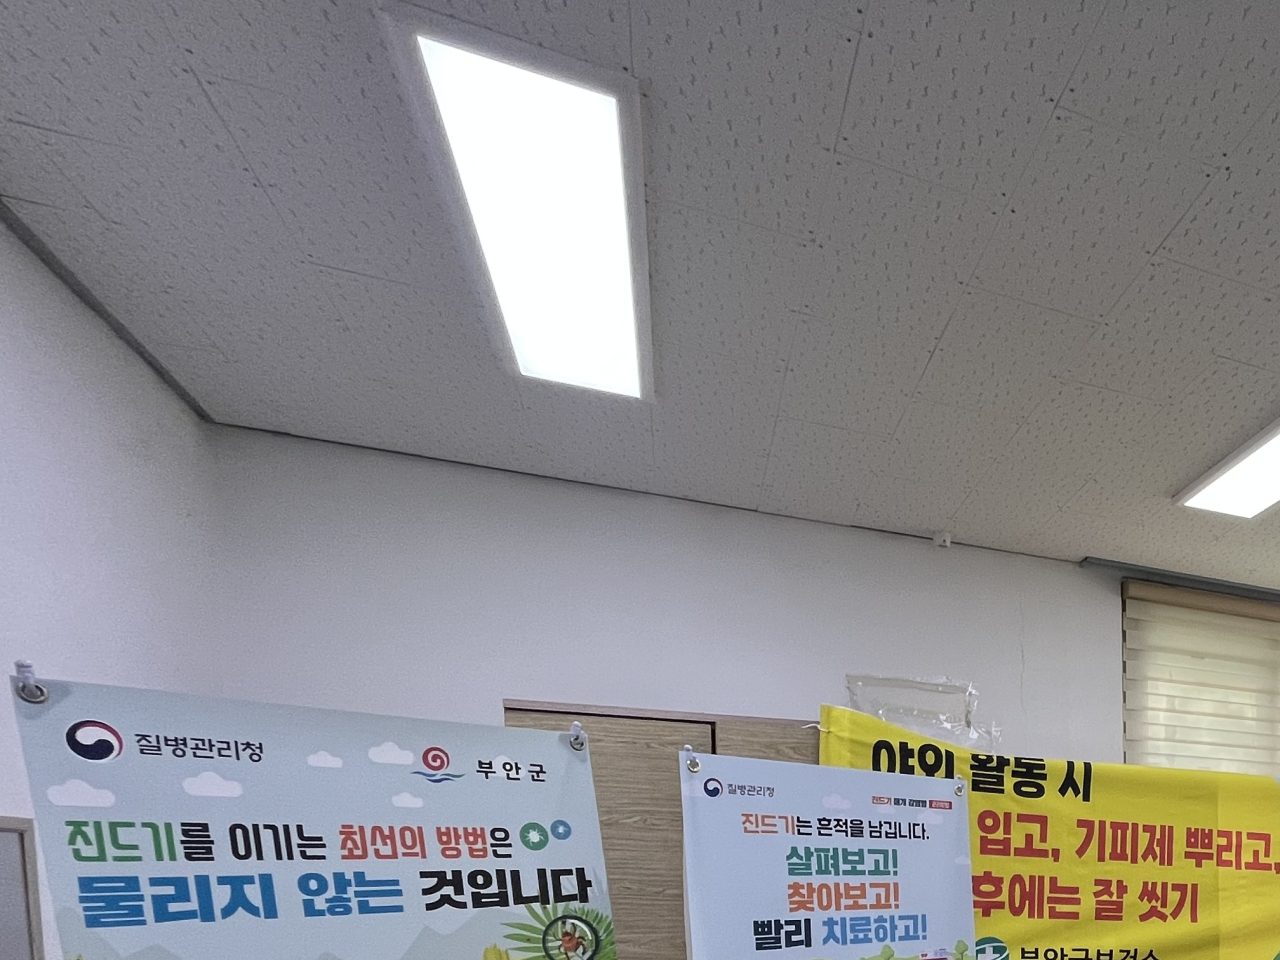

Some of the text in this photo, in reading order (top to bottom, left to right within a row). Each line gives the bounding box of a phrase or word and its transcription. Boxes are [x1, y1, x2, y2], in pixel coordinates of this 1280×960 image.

[135, 732, 264, 763] 질병관리청
[727, 784, 775, 797] 질병관리청
[969, 753, 1048, 800] 활동
[1058, 760, 1092, 802] 시
[65, 819, 512, 863] 진드기를 이기는 최선의 방법은
[741, 813, 930, 841] 진드기는 흔적을 남깁니다.
[977, 810, 1280, 874] 입고, 기피제 뿌리고,
[786, 846, 898, 876] 살펴보고!
[77, 867, 593, 928] 물리지 않는 것입니다
[787, 882, 900, 912] 찾아보고!
[972, 871, 1199, 923] 후에는 잘 씻기
[753, 914, 927, 951] 빨리 치료하고!
